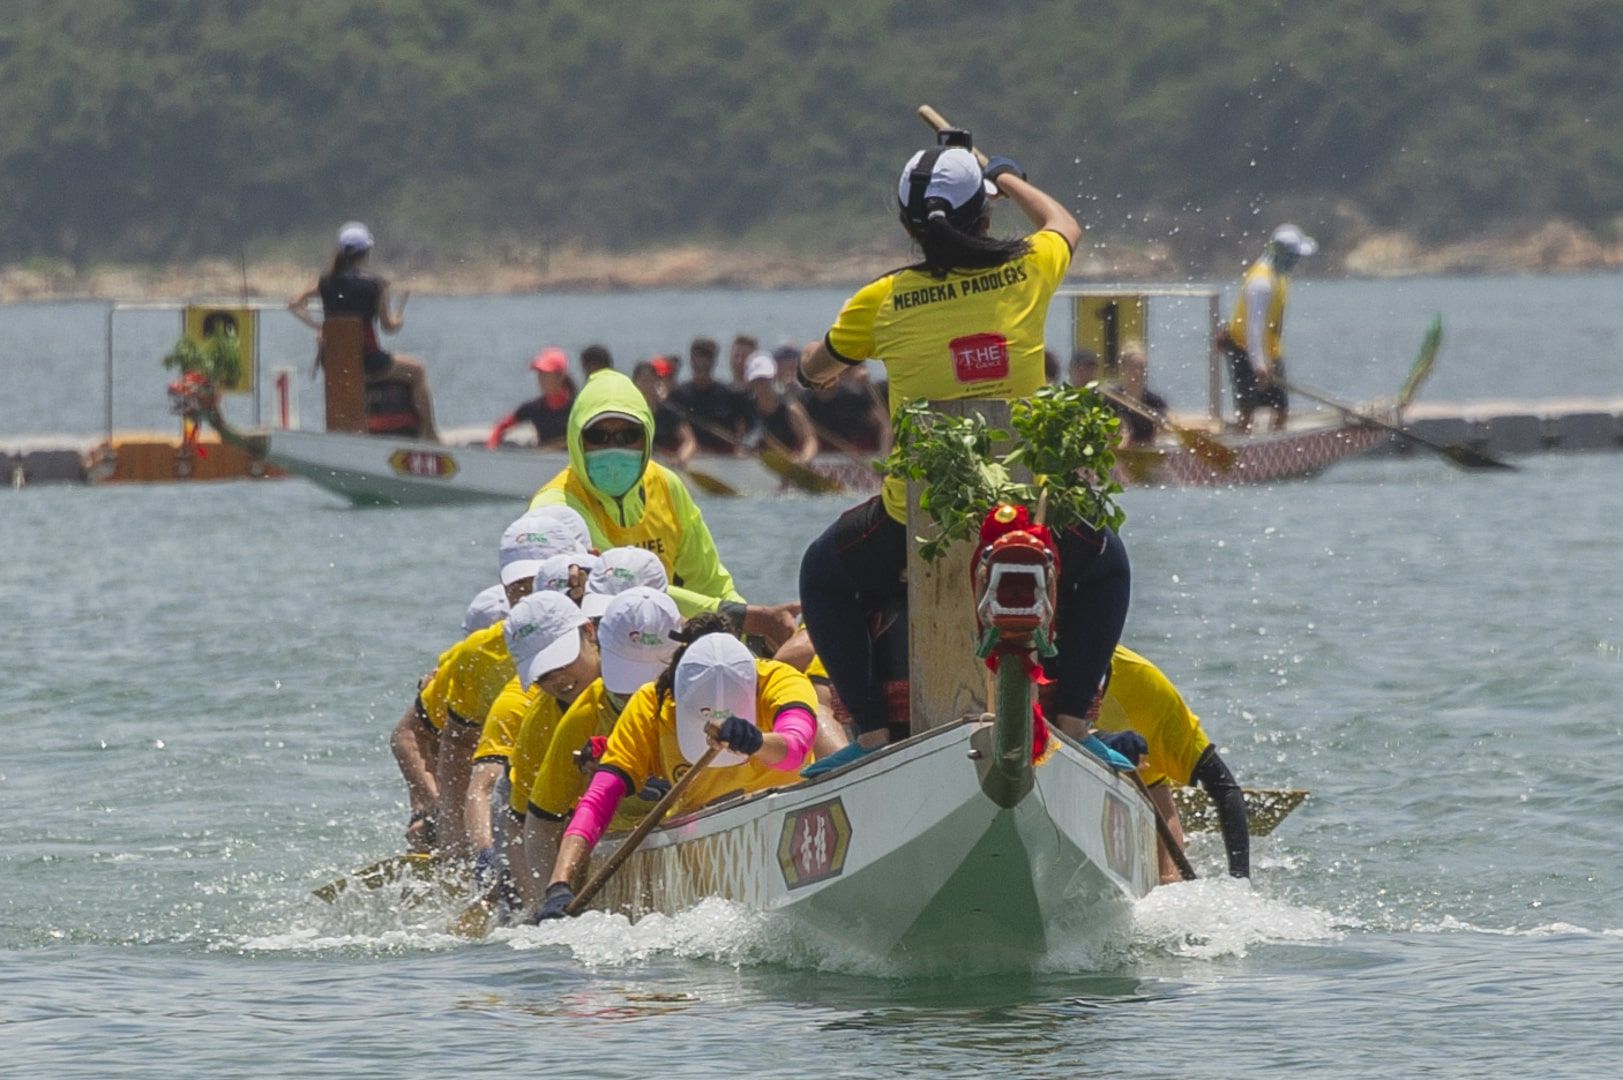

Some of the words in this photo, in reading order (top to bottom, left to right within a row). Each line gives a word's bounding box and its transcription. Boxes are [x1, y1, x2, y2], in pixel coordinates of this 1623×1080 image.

[893, 283, 958, 312] MERDEKA
[960, 265, 1028, 297] PADDLERS
[960, 345, 1001, 366] THE
[635, 538, 665, 554] IFE
